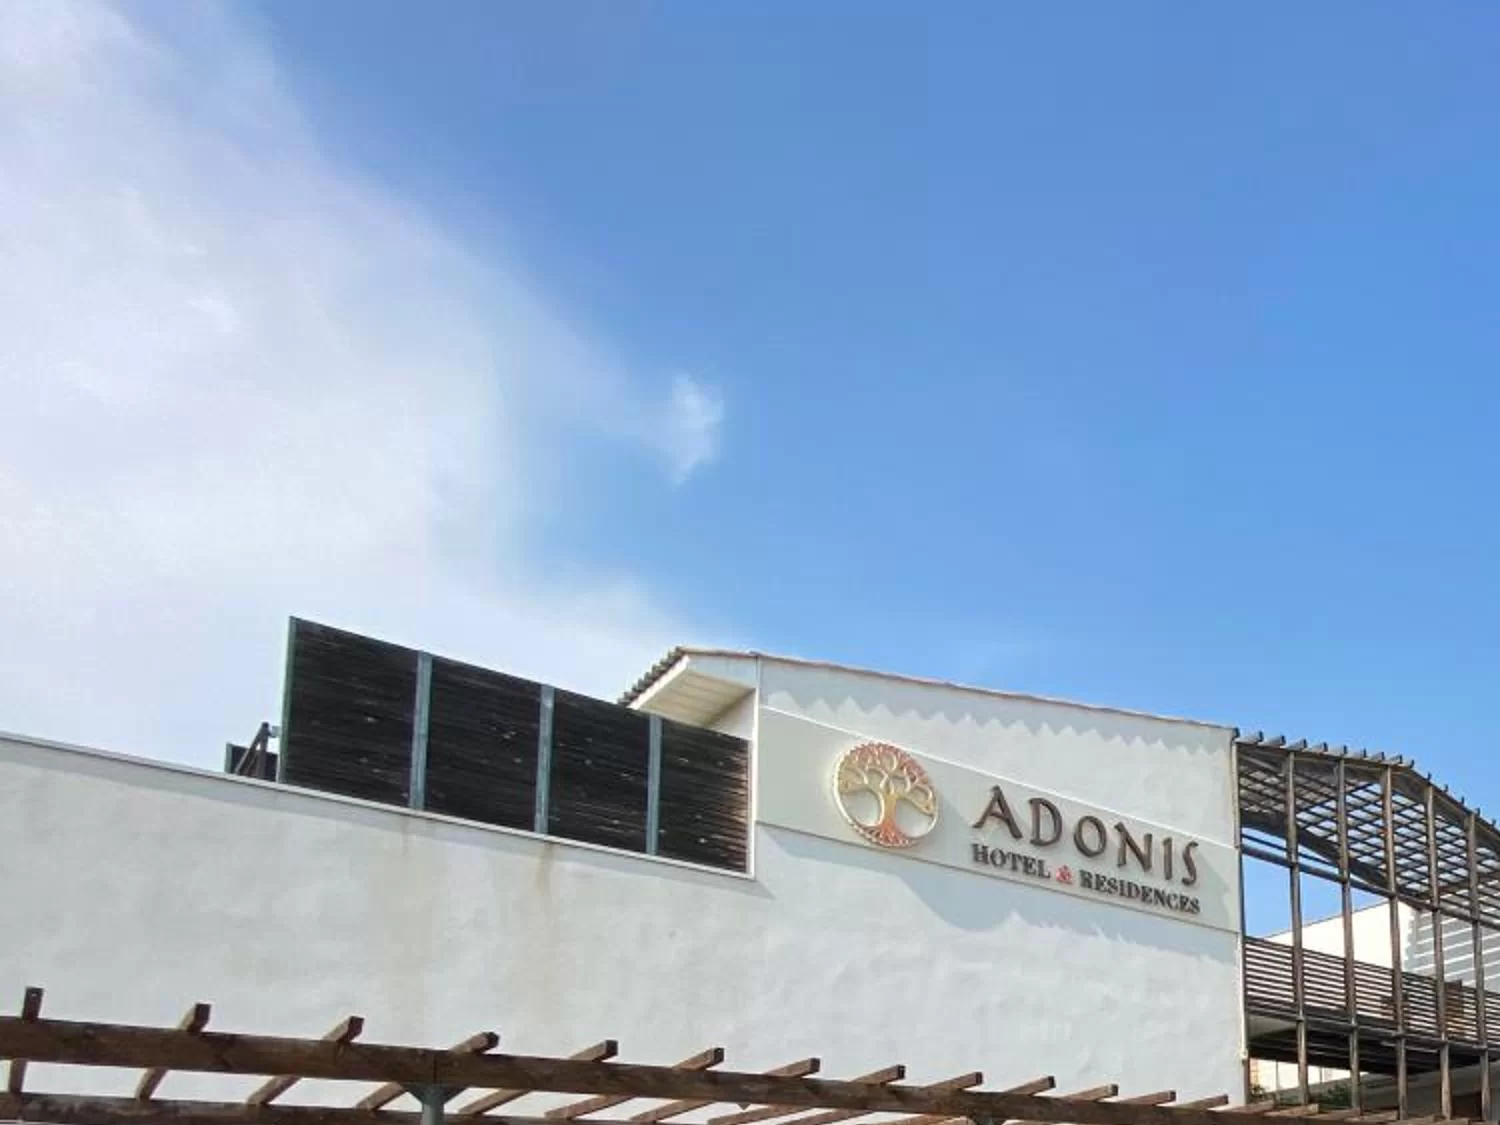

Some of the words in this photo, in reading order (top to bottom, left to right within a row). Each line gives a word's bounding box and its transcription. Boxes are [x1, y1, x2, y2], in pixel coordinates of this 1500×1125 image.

[972, 843, 1050, 880] HOTEL
[1055, 864, 1074, 884] &
[1079, 870, 1200, 914] RESIDENCES
[973, 785, 1199, 886] ADONIS
